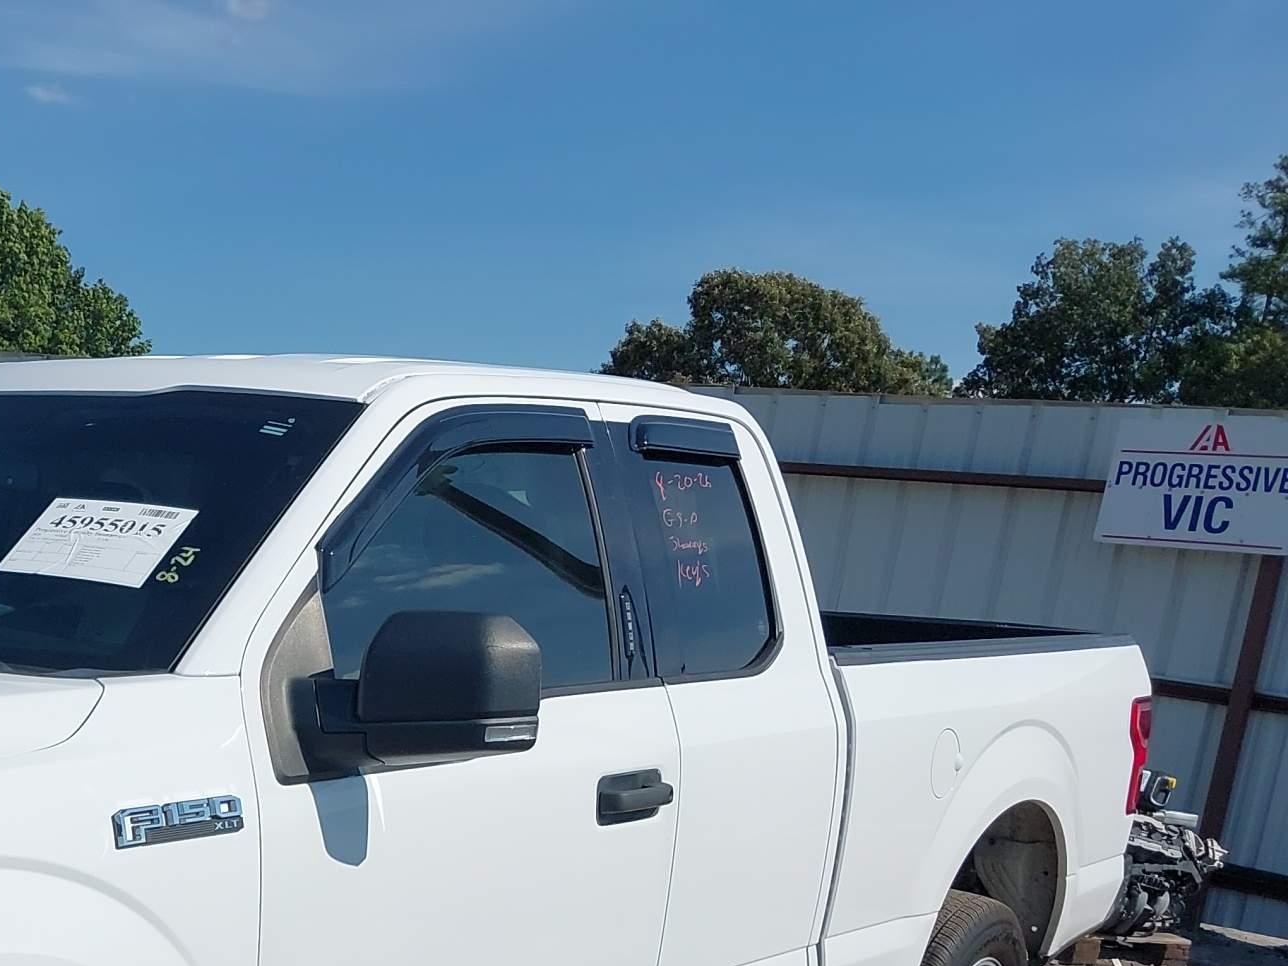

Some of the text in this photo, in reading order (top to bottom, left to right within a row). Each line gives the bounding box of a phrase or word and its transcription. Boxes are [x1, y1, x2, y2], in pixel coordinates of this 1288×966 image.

[49, 512, 167, 538] 45955015
[1163, 494, 1234, 535] VIC
[155, 545, 201, 584] 8-24
[111, 794, 243, 850] F150
[214, 819, 240, 831] XLT
